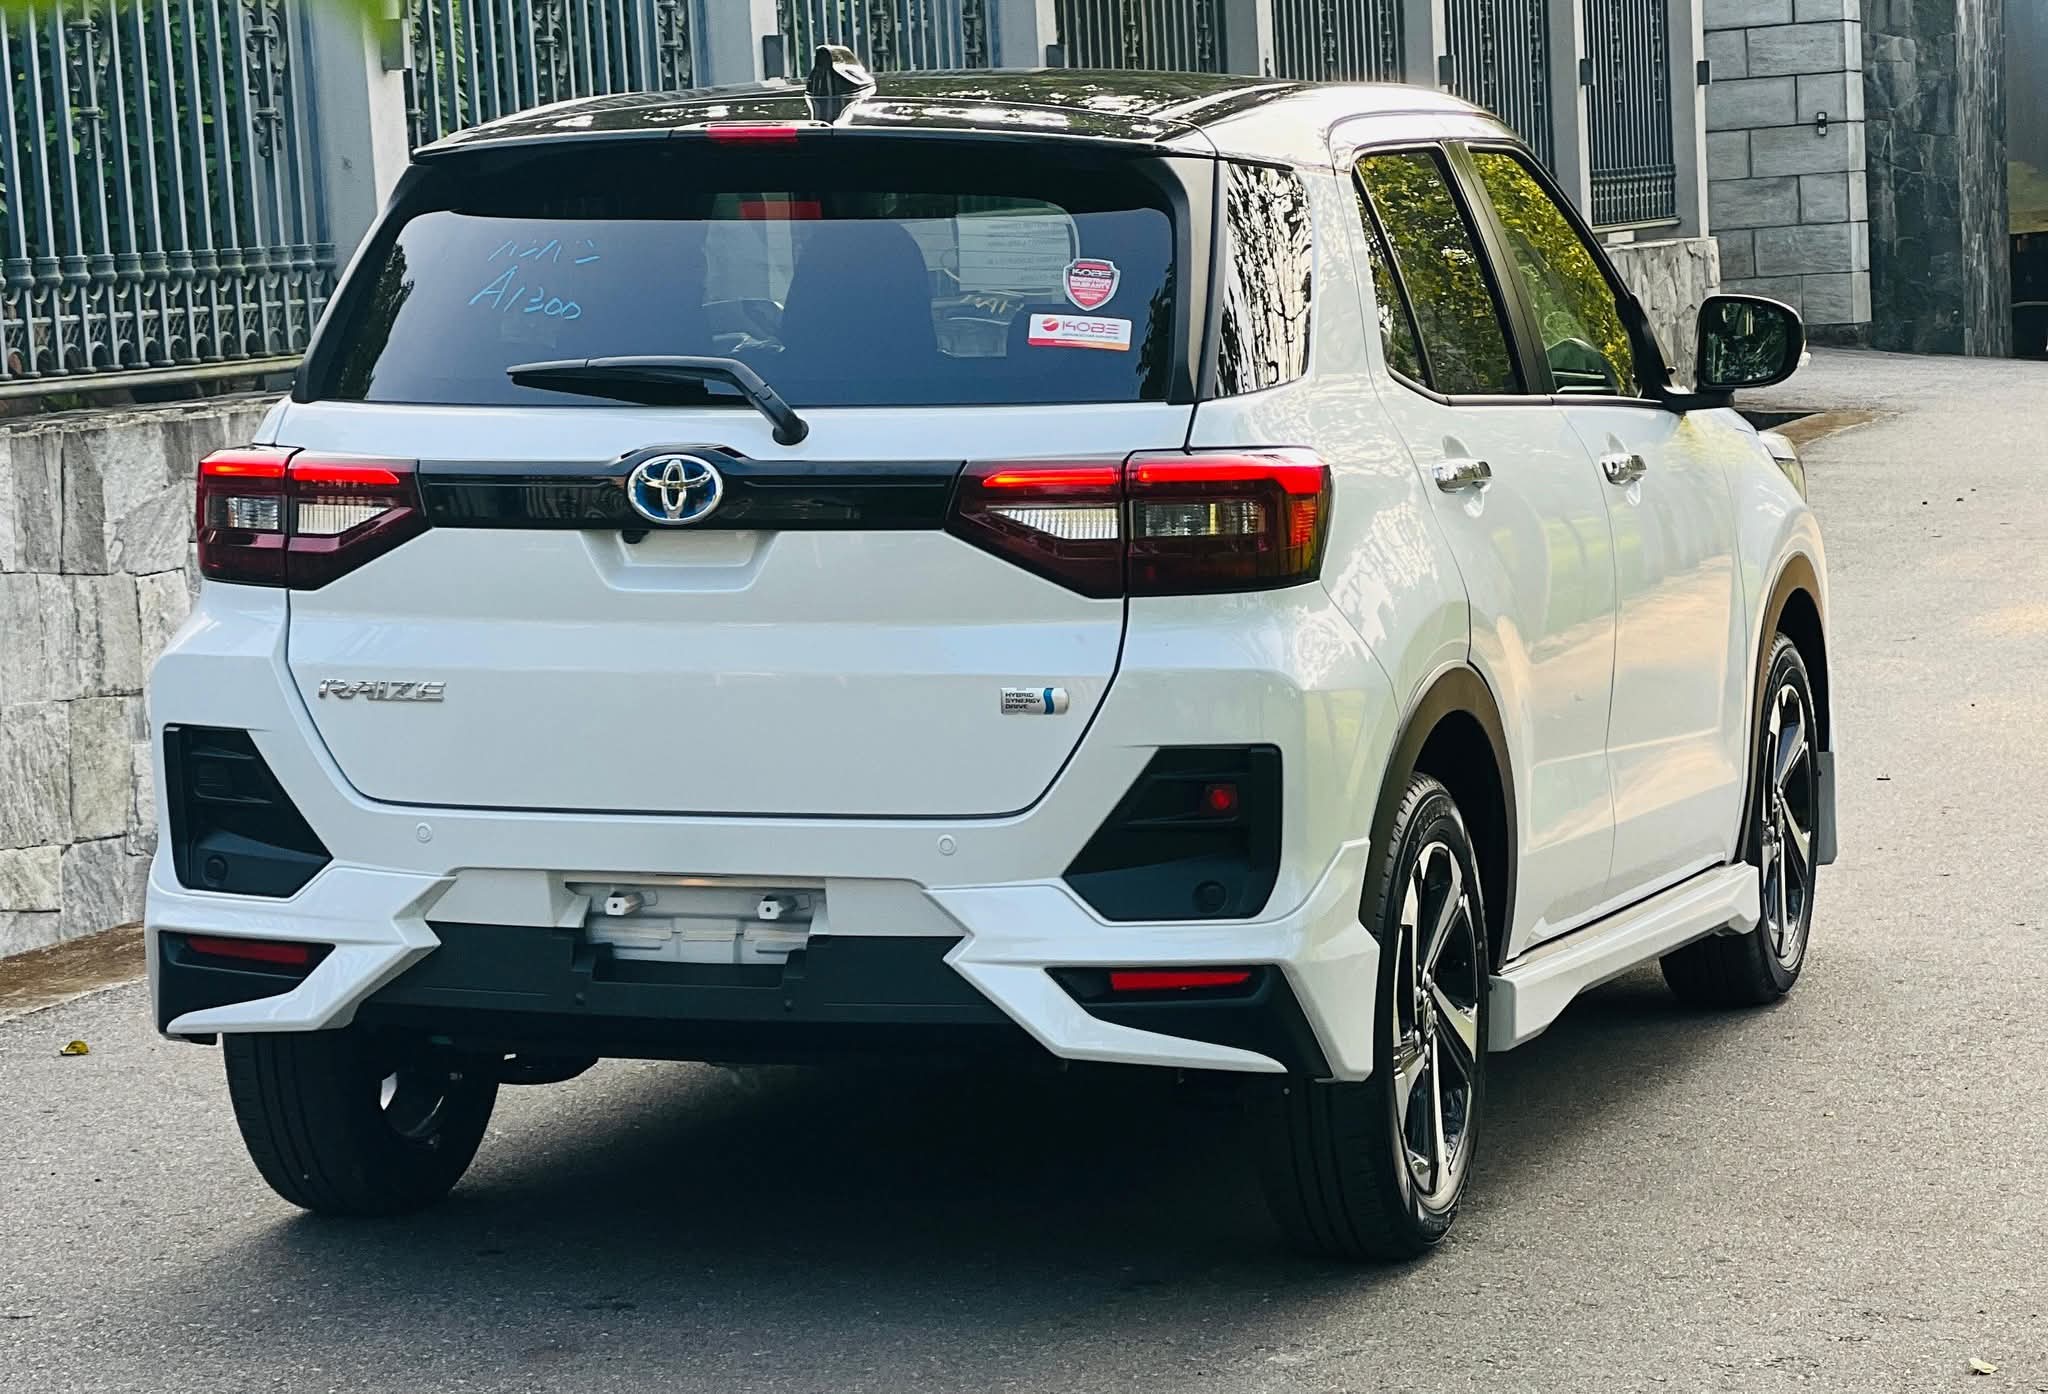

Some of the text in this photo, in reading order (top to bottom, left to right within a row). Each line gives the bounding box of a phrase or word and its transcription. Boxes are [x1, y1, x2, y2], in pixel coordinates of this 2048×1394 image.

[1072, 268, 1112, 278] KOBE
[1062, 320, 1120, 335] KOBE
[318, 678, 447, 702] RAIZE
